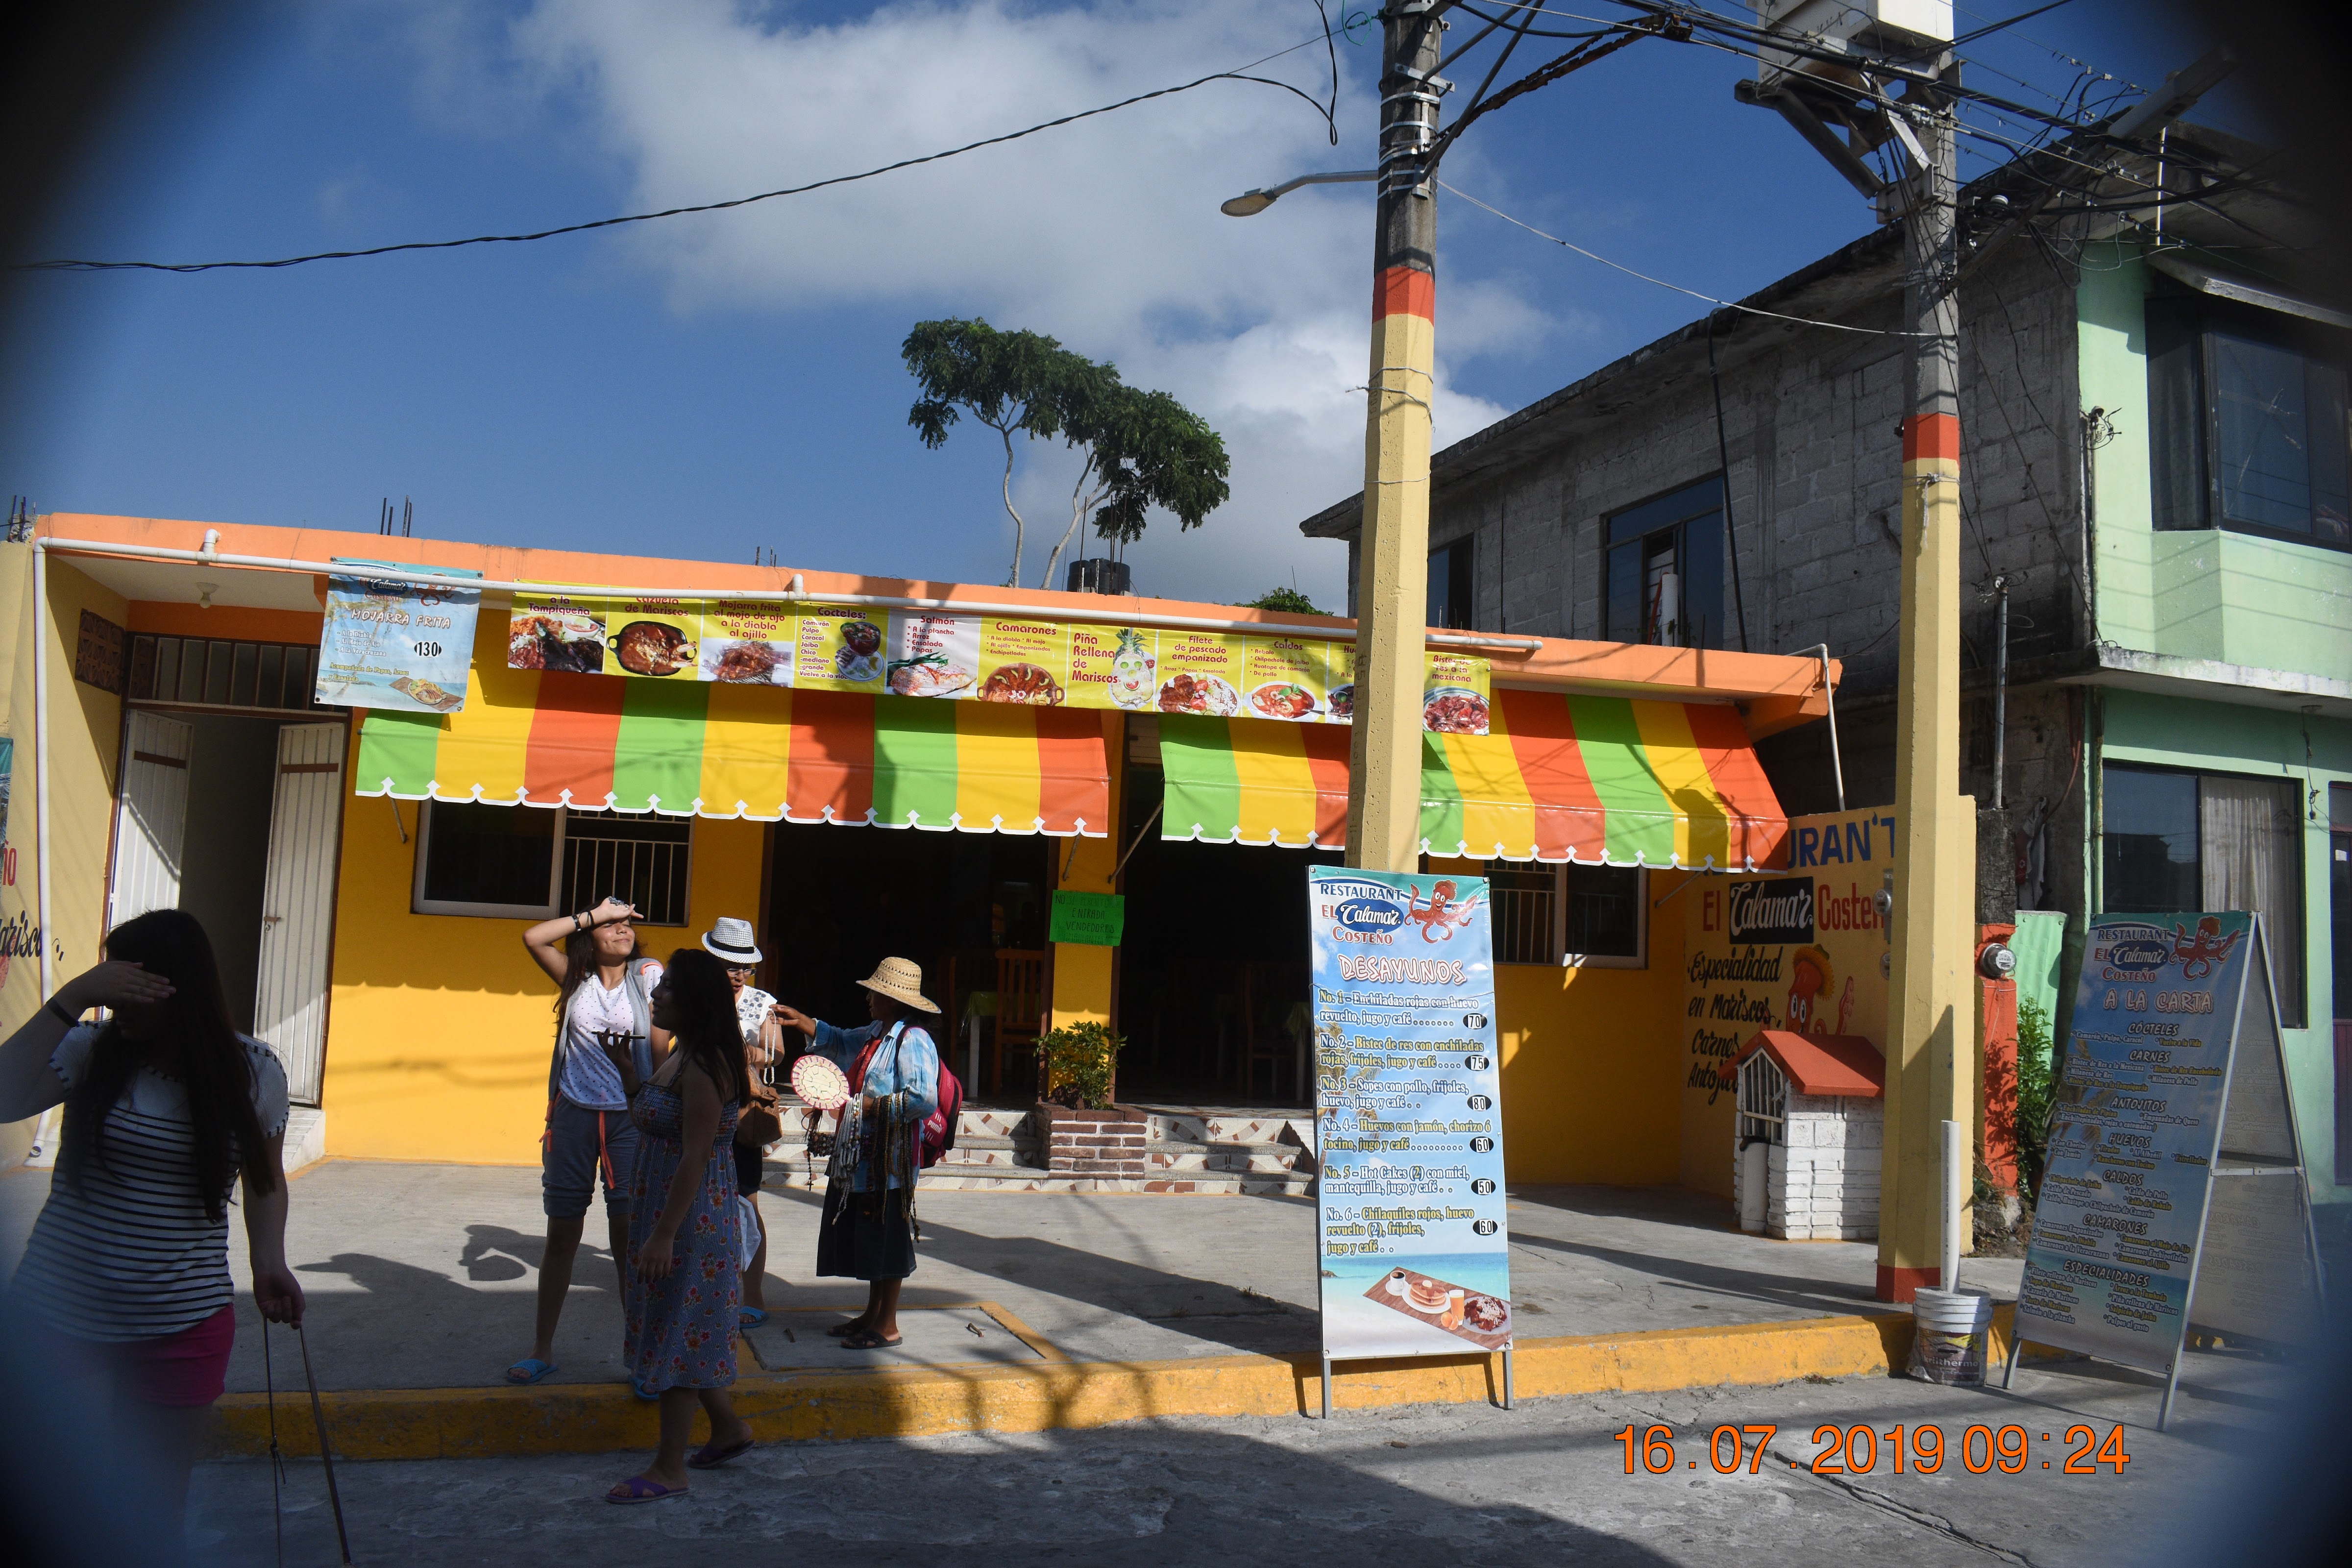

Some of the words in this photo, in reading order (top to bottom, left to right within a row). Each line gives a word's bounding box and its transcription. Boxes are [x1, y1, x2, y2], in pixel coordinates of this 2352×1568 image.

[560, 596, 570, 604] la
[719, 599, 757, 611] Mojarra
[760, 602, 781, 612] frita
[529, 603, 590, 616] Tampiqueña
[625, 604, 639, 612] de
[642, 604, 689, 616] Mariscos
[726, 611, 750, 620] mojo
[753, 612, 766, 621] de
[768, 613, 785, 622] ajo
[817, 607, 866, 619] Cocteles:
[351, 609, 410, 625] MOJARRA
[416, 615, 451, 629] FRITA
[731, 619, 741, 628] la
[744, 620, 776, 631] diabla
[920, 615, 955, 625] Salmón
[729, 629, 739, 637] al
[742, 630, 767, 640] ajillo
[996, 621, 1057, 636] Camarones
[1074, 633, 1098, 645] Piña
[1189, 636, 1213, 644] Filete
[1274, 641, 1303, 650] Caldos
[352, 648, 386, 656] Veracruzana
[419, 642, 438, 657] 130
[1073, 645, 1115, 658] Rellena
[1189, 645, 1226, 655] pescado
[1073, 658, 1087, 668] de
[1172, 654, 1228, 664] empanizado
[330, 662, 365, 672] Acompañada
[374, 666, 392, 675] Papas,
[1072, 670, 1118, 684] Mariscos
[1432, 674, 1471, 682] mexicana
[1320, 883, 1402, 900] RESTAURANT
[1055, 895, 1065, 905] NO
[1072, 907, 1104, 919] ENTRADA
[1322, 905, 1338, 919] EL
[1703, 890, 1720, 931] El
[1066, 921, 1114, 933] VENDEDORES
[2097, 930, 2169, 941] RESTAURANT
[2094, 948, 2111, 961] EL
[1337, 955, 1467, 984] DESAYUNOS
[1688, 945, 1783, 988] Especialidad
[1320, 989, 1335, 1003] No.
[1338, 990, 1343, 1004] 1
[1352, 992, 1403, 1006] Enchiladas
[1406, 995, 1429, 1009] rojas
[1431, 999, 1448, 1008] con
[1449, 996, 1478, 1008] huevo
[2104, 988, 2117, 1010] A
[2126, 989, 2147, 1011] LA
[2155, 991, 2213, 1013] CARTA
[1689, 996, 1706, 1018] en
[1469, 1015, 1480, 1028] 70
[2128, 1021, 2179, 1036] CÓCTELES
[1320, 1033, 1337, 1048] No.
[1339, 1035, 1346, 1048] 2
[1355, 1036, 1383, 1050] Bistec
[1385, 1037, 1396, 1050] de
[1398, 1041, 1413, 1051] res
[1415, 1041, 1431, 1051] con
[1434, 1039, 1484, 1052] enchiladas
[1350, 1053, 1385, 1069] frijoles,
[1387, 1054, 1408, 1069] jugo
[1409, 1058, 1416, 1069] y
[1472, 1057, 1483, 1069] 75
[2129, 1050, 2170, 1063] CARNES
[1357, 1078, 1383, 1093] Sopes
[1385, 1081, 1402, 1092] con
[1404, 1079, 1431, 1095] pollo,
[1432, 1079, 1469, 1095] frijoles,
[1322, 1093, 1354, 1109] huevo,
[1473, 1098, 1485, 1110] 80
[2110, 1096, 2166, 1112] ANTOJITOS
[928, 1120, 942, 1134] PUMA
[1359, 1119, 1394, 1132] Huevos
[1415, 1120, 1447, 1135] jamón,
[1449, 1119, 1483, 1132] chorizo
[1323, 1136, 1357, 1152] tocino,
[1477, 1139, 1489, 1151] 60
[2108, 1132, 2151, 1149] HUEVOS
[1360, 1166, 1378, 1179] Hot
[1379, 1166, 1408, 1179] Cakes
[1409, 1166, 1424, 1181] (2)
[1426, 1168, 1445, 1179] con
[1445, 1165, 1470, 1181] miel,
[2103, 1170, 2144, 1185] CALDOS
[1325, 1180, 1385, 1196] mantequilla,
[1479, 1181, 1490, 1194] 50
[1362, 1206, 1416, 1221] Chilaquiles
[1417, 1206, 1444, 1222] rojos,
[1445, 1206, 1474, 1219] huevo
[1480, 1221, 1492, 1233] 60
[2083, 1213, 2148, 1235] CAMARONES
[2063, 1259, 2150, 1287] ESPECIALIDADES
